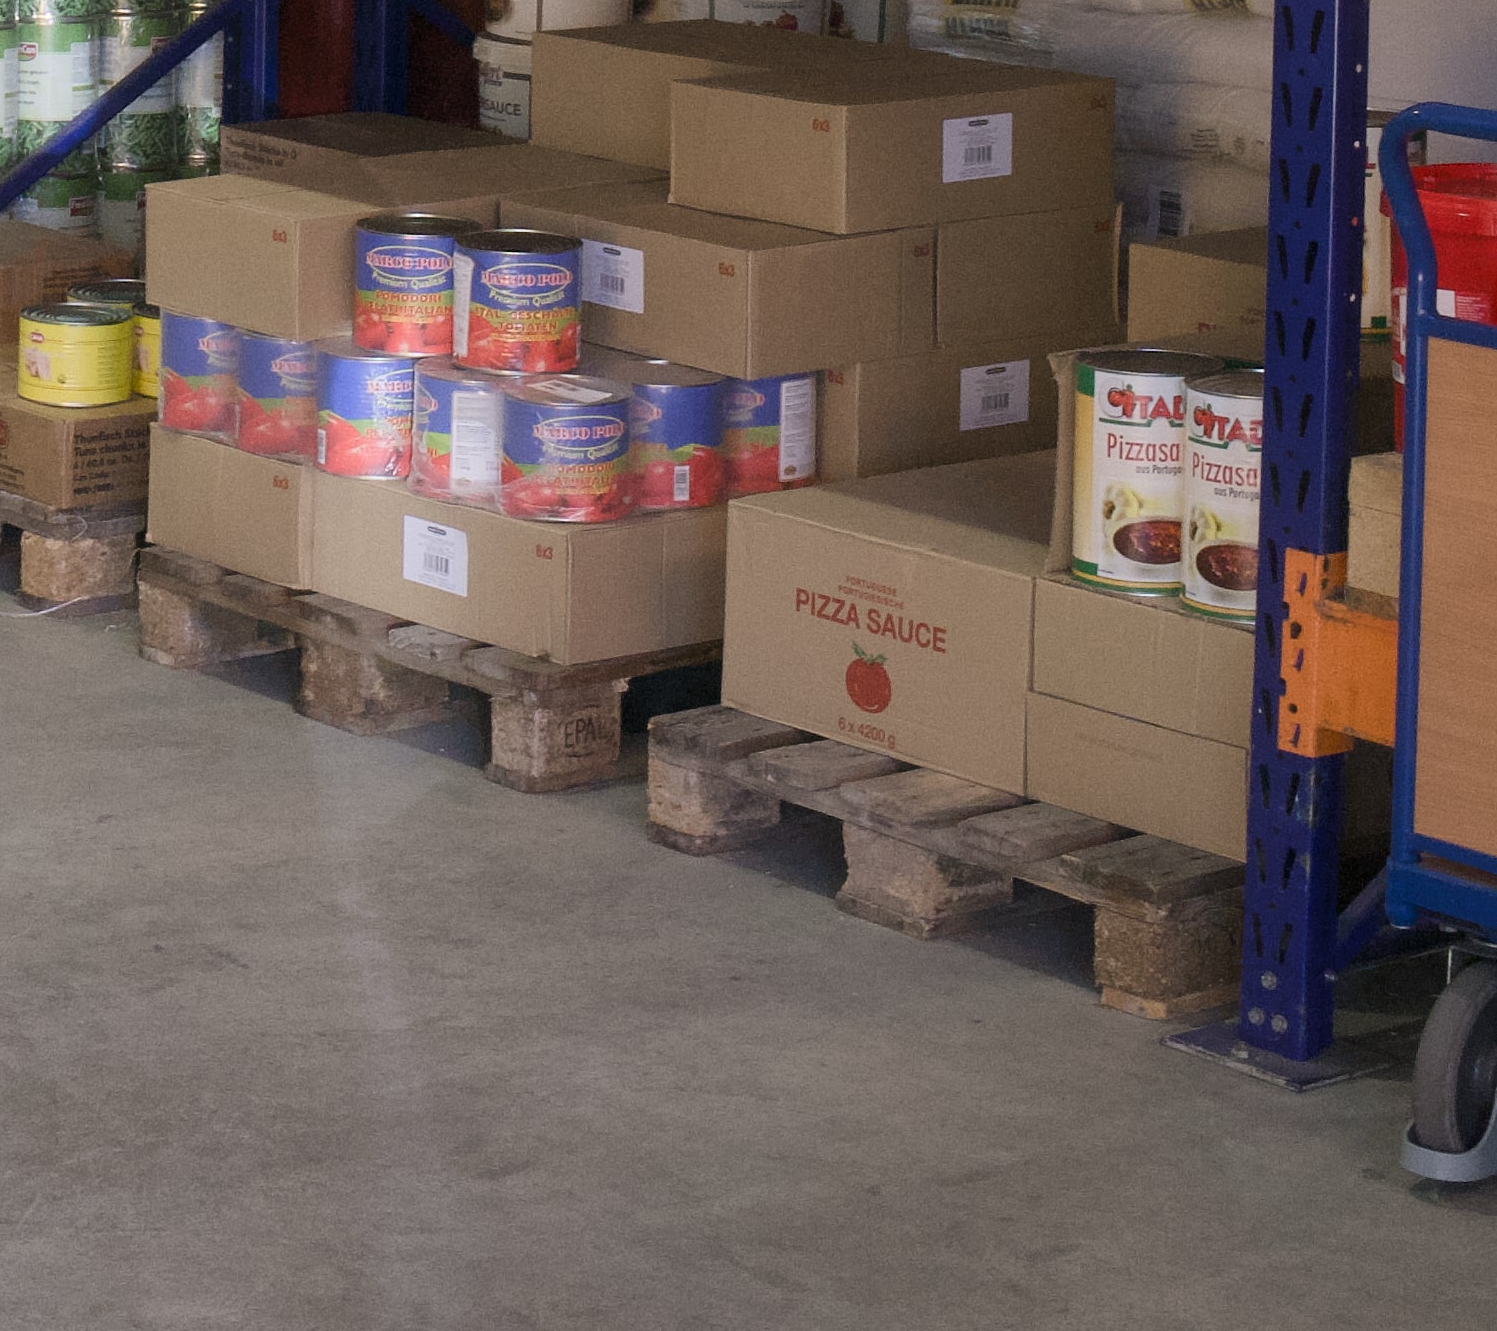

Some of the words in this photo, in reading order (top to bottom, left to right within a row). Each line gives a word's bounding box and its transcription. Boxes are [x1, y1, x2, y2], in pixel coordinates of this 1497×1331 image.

[795, 588, 860, 629] PIZZA
[867, 608, 947, 653] SAUCE
[838, 717, 845, 731] 6
[848, 723, 854, 732] x
[858, 724, 886, 743] 4200
[888, 735, 895, 749] g
